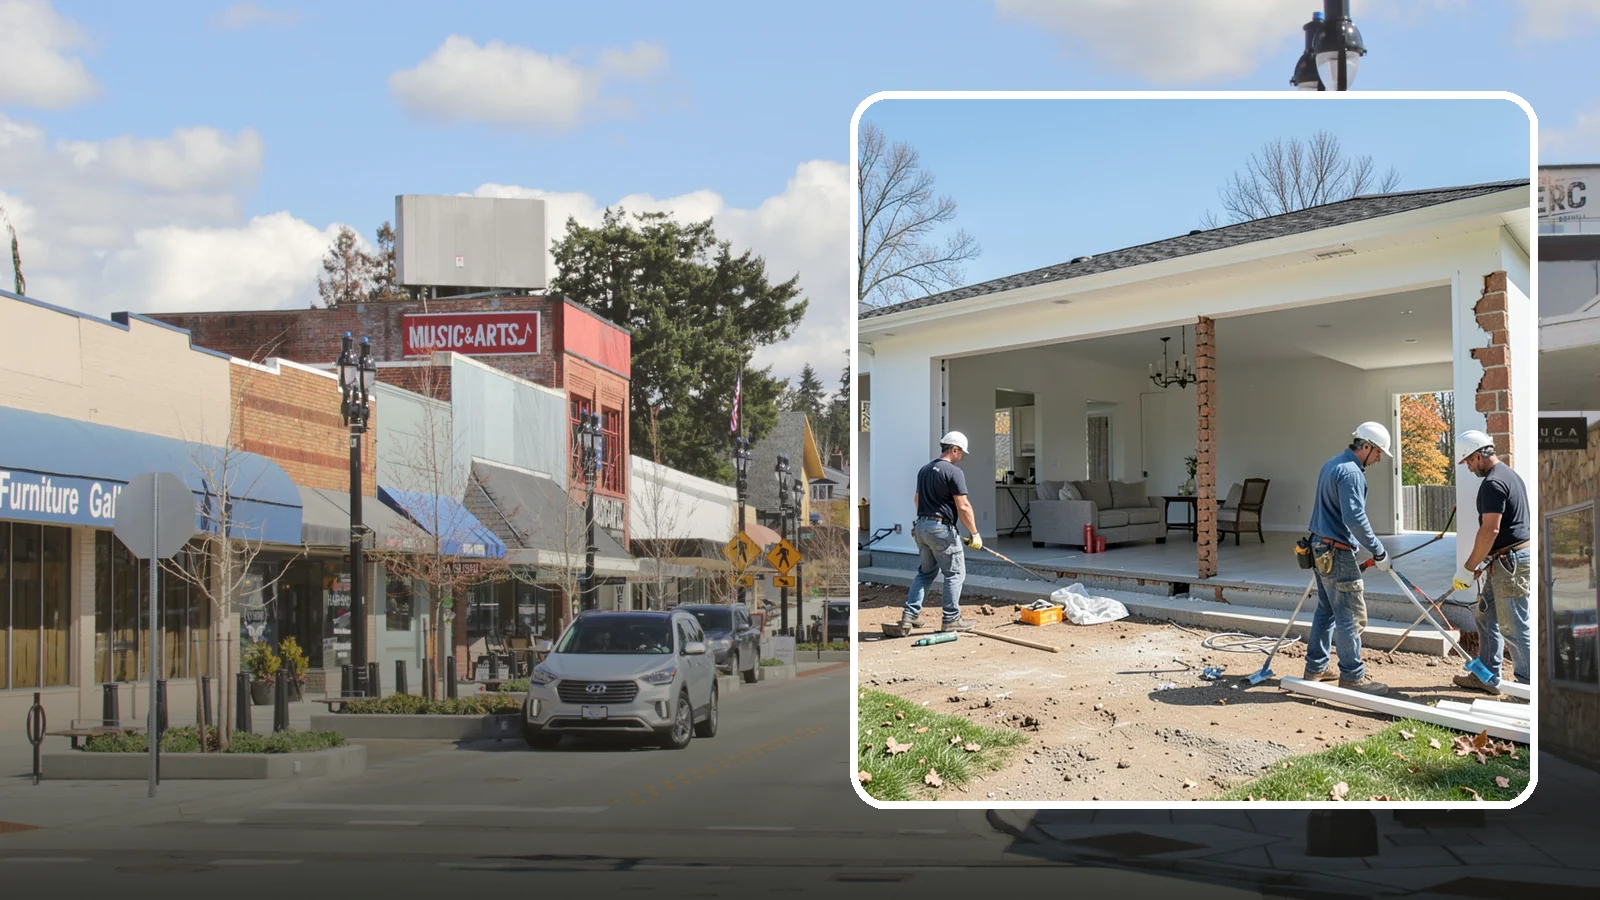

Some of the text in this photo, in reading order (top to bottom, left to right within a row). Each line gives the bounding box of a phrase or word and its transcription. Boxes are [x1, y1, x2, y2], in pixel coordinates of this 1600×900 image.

[0, 470, 122, 519] Furniture Gal
[453, 563, 479, 574] SUSHI
[327, 594, 340, 606] HAIR
